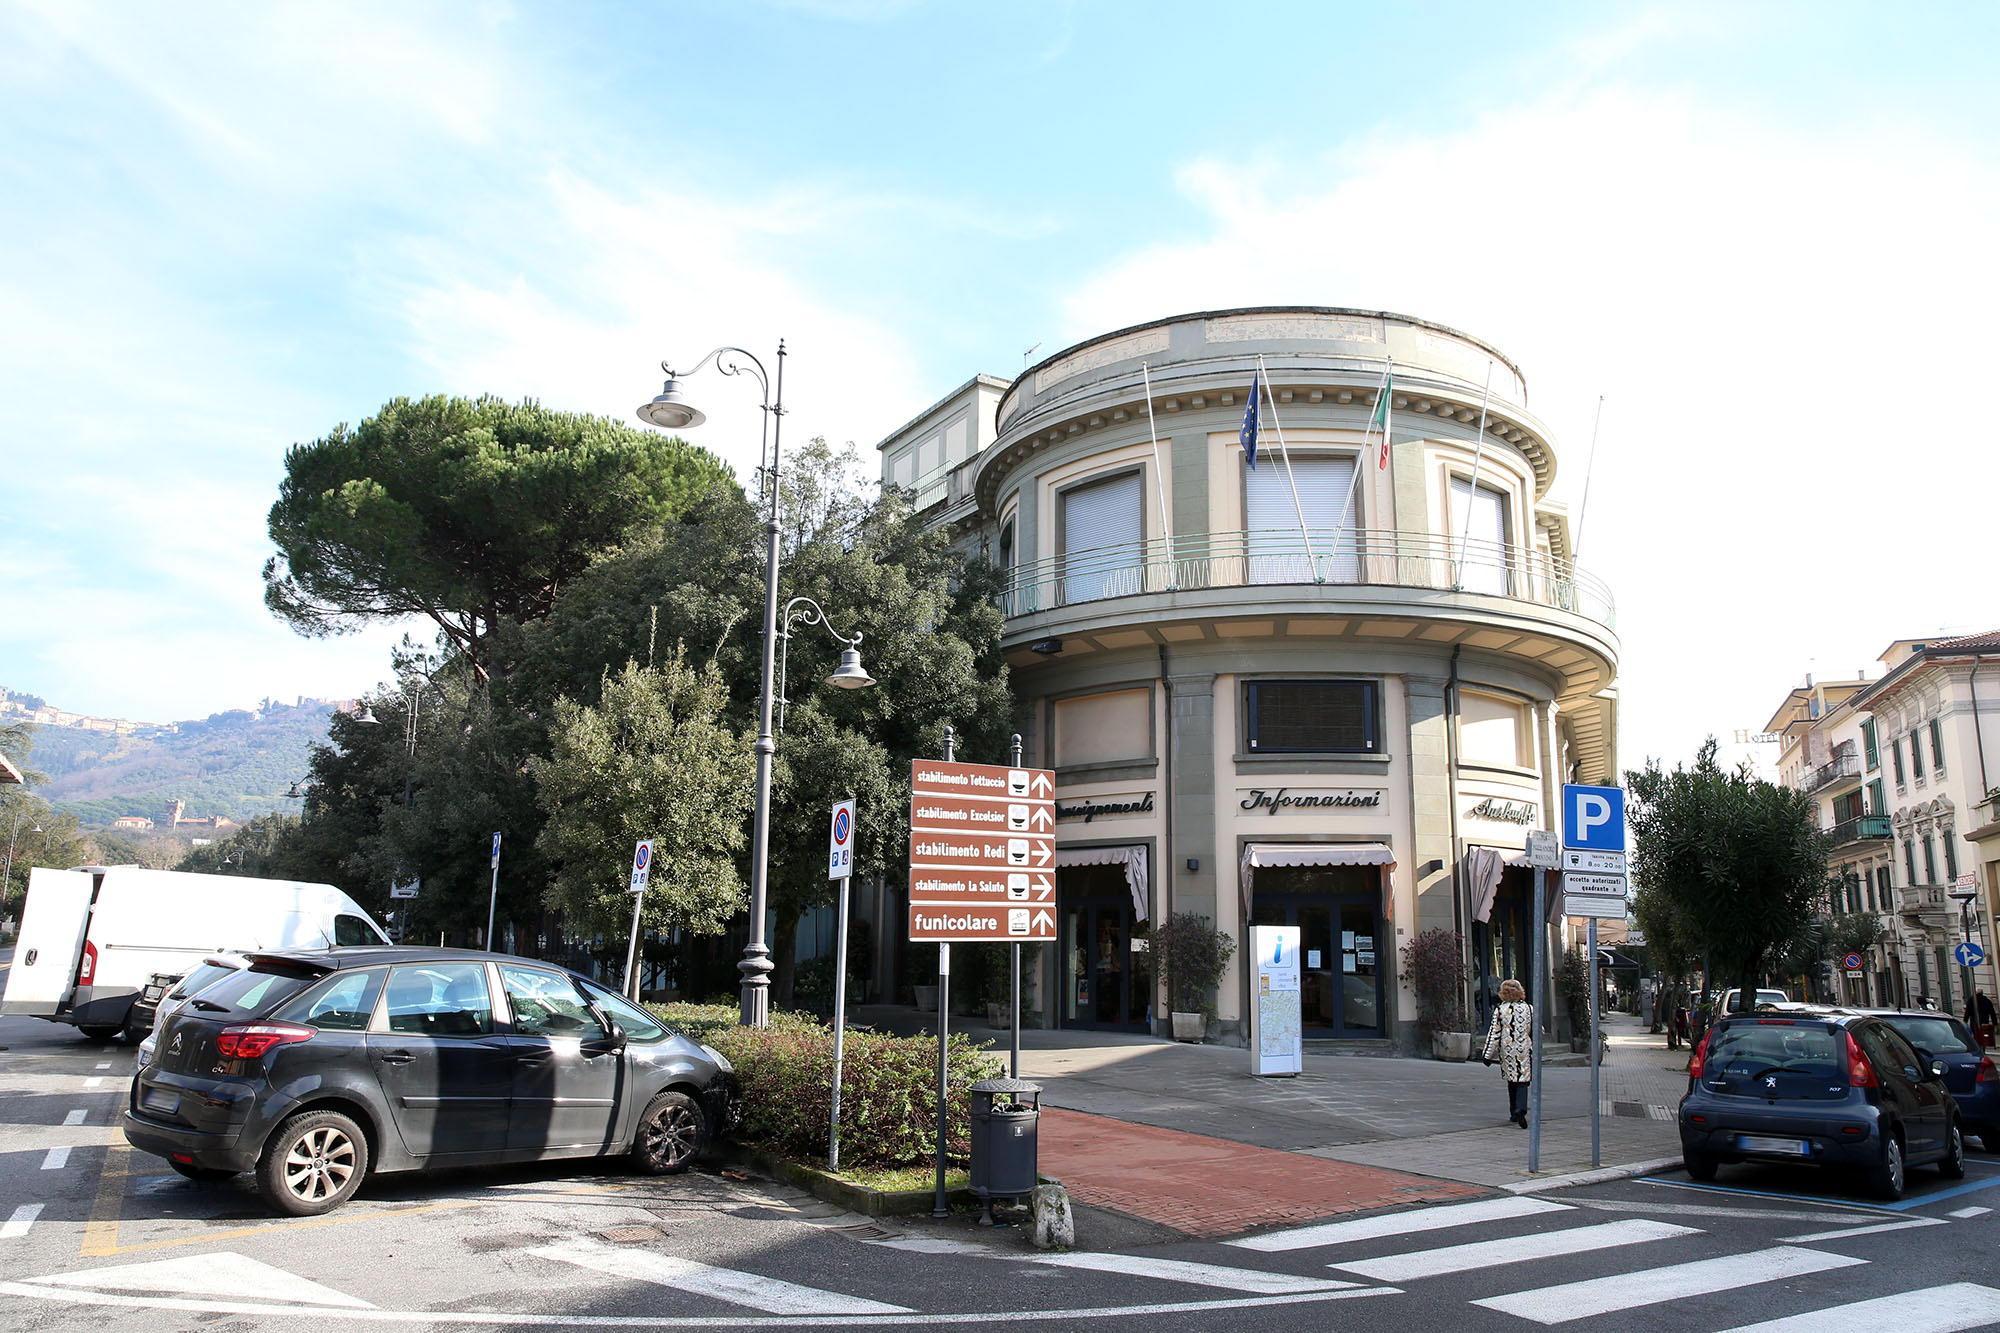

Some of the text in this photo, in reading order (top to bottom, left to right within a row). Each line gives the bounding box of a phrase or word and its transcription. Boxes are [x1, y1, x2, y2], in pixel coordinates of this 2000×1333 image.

[1734, 729, 1780, 744] HOTEL
[917, 770, 1006, 788] stabilimento Tettuccio
[1240, 788, 1381, 815] Informazioni
[916, 806, 1006, 823] stabilimento Excelsior
[1576, 793, 1611, 841] P
[915, 842, 1006, 859] stabilimento Redi
[915, 878, 1005, 893] stabilimento La Salute
[915, 913, 998, 931] funicolare
[211, 1066, 224, 1074] C4
